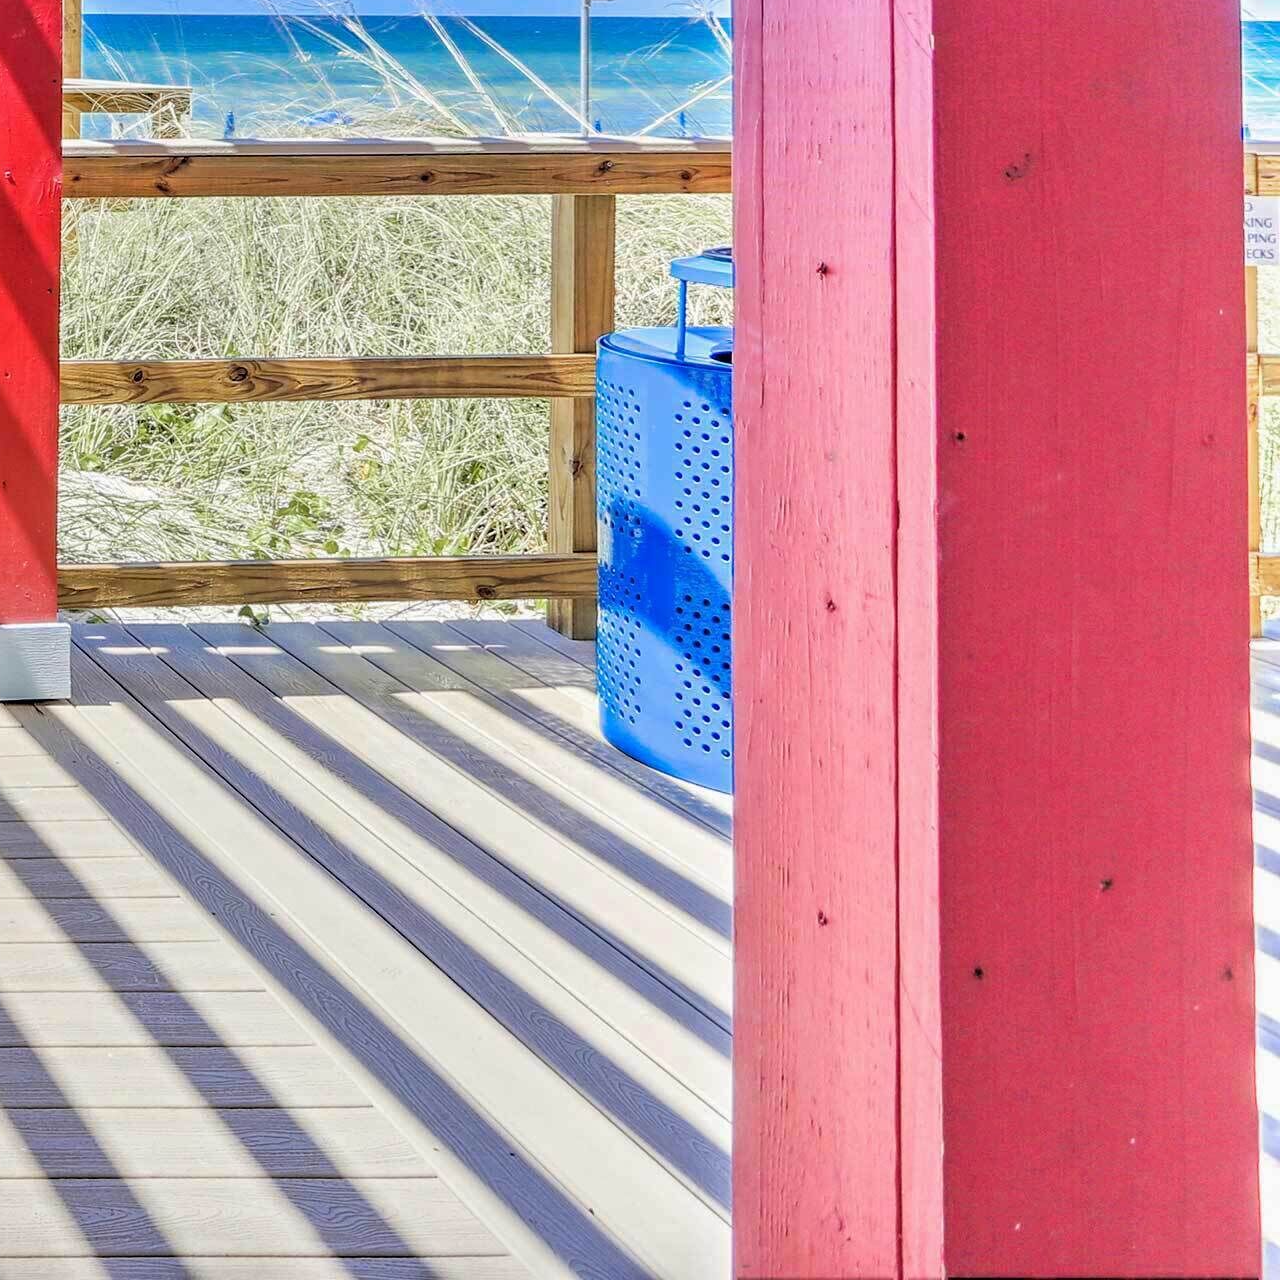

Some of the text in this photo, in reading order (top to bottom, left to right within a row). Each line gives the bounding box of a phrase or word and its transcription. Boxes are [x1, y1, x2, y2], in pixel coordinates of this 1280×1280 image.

[1245, 218, 1272, 228] KING
[1248, 234, 1276, 244] PING
[1247, 249, 1274, 259] ECKS
